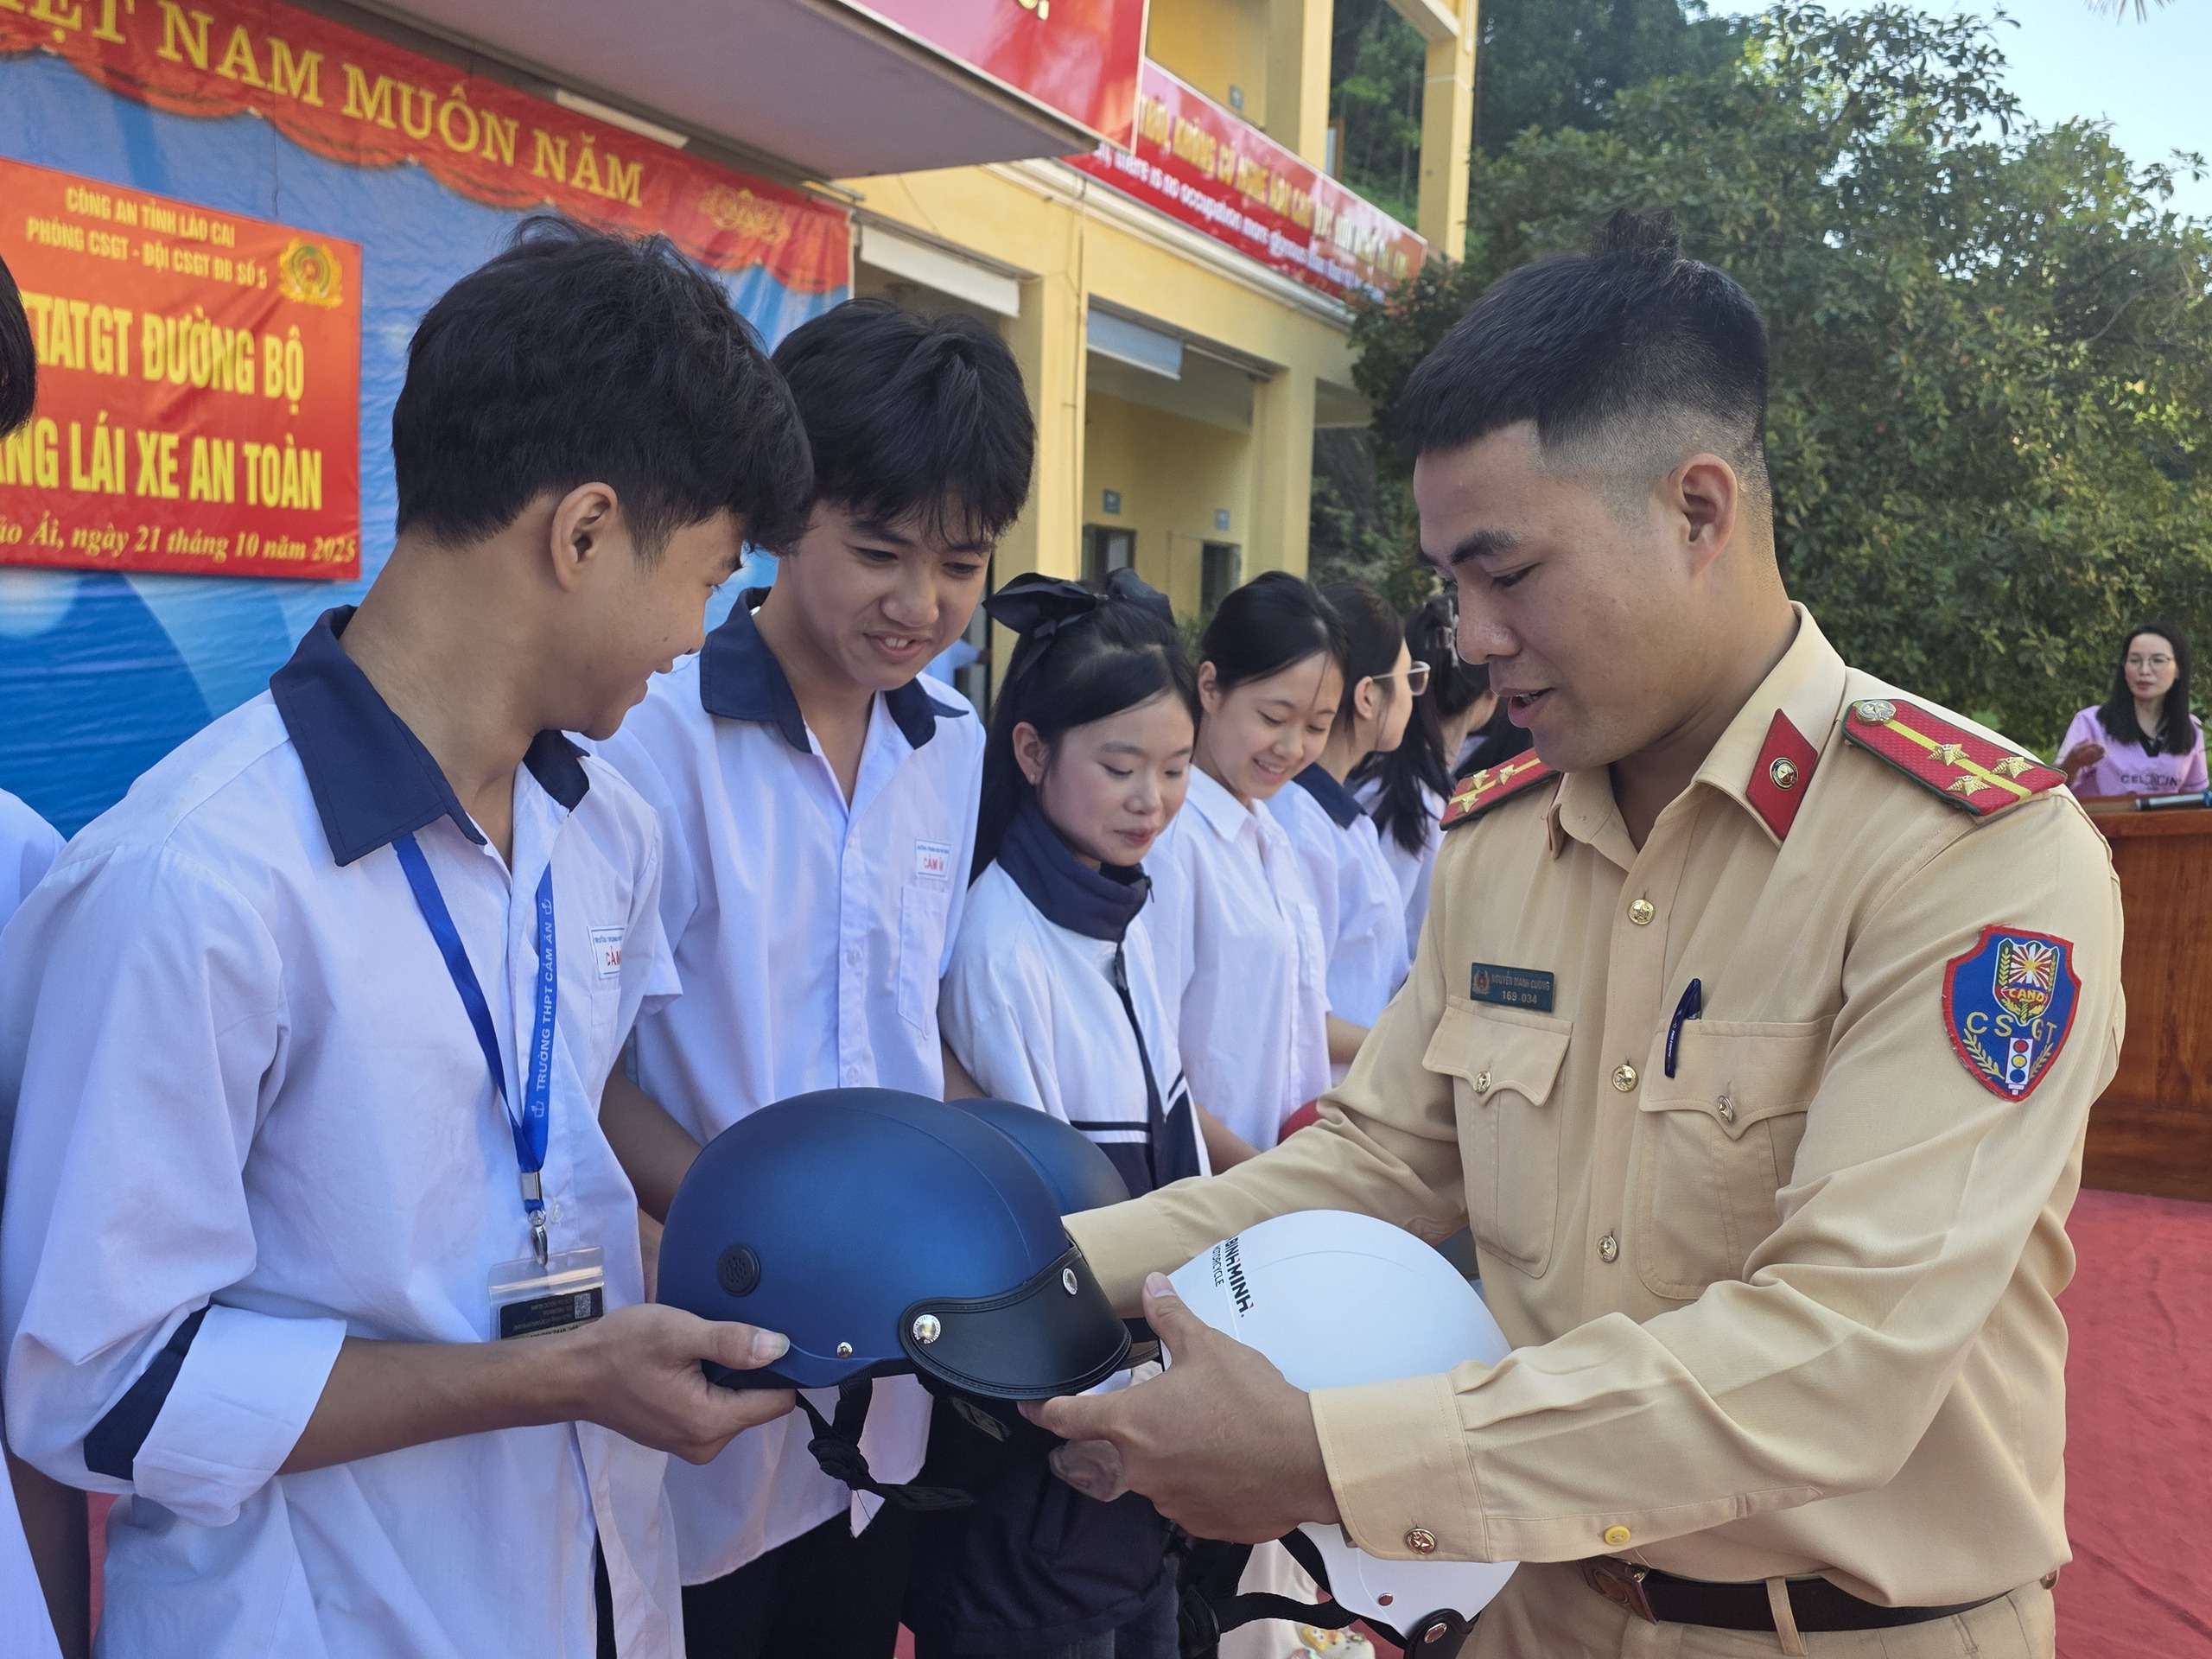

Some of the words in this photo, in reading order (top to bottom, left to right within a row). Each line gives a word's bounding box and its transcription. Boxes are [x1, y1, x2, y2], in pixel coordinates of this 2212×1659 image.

[156, 0, 324, 107] NAM
[341, 62, 519, 167] MUÔN
[532, 129, 645, 208] NĂM
[65, 184, 111, 220] CÔNG
[115, 198, 137, 226] AN
[179, 210, 208, 242] LÀO
[210, 220, 235, 248] CAI
[1179, 183, 1243, 231] occupation
[26, 215, 85, 251] PHÒNG
[88, 229, 129, 260] CSGT
[142, 239, 169, 272] ĐỘI
[173, 247, 210, 277] CSGT
[236, 257, 255, 287] SỐ
[19, 289, 132, 378] TATGT
[141, 307, 255, 395] ĐƯỜNG
[263, 324, 305, 415] BỘ
[70, 410, 126, 495] LÁI
[135, 430, 179, 499] XE
[189, 435, 235, 503] AN
[244, 433, 322, 511] TOÀN
[71, 522, 130, 557] ngày
[135, 524, 160, 553] 21
[166, 527, 230, 563] tháng
[235, 531, 259, 558] 10
[263, 534, 308, 561] năm
[311, 535, 356, 563] 2025
[543, 987, 553, 1024] THPT
[2008, 988, 2045, 1003] CAND
[536, 1028, 551, 1092] TRƯỜNG
